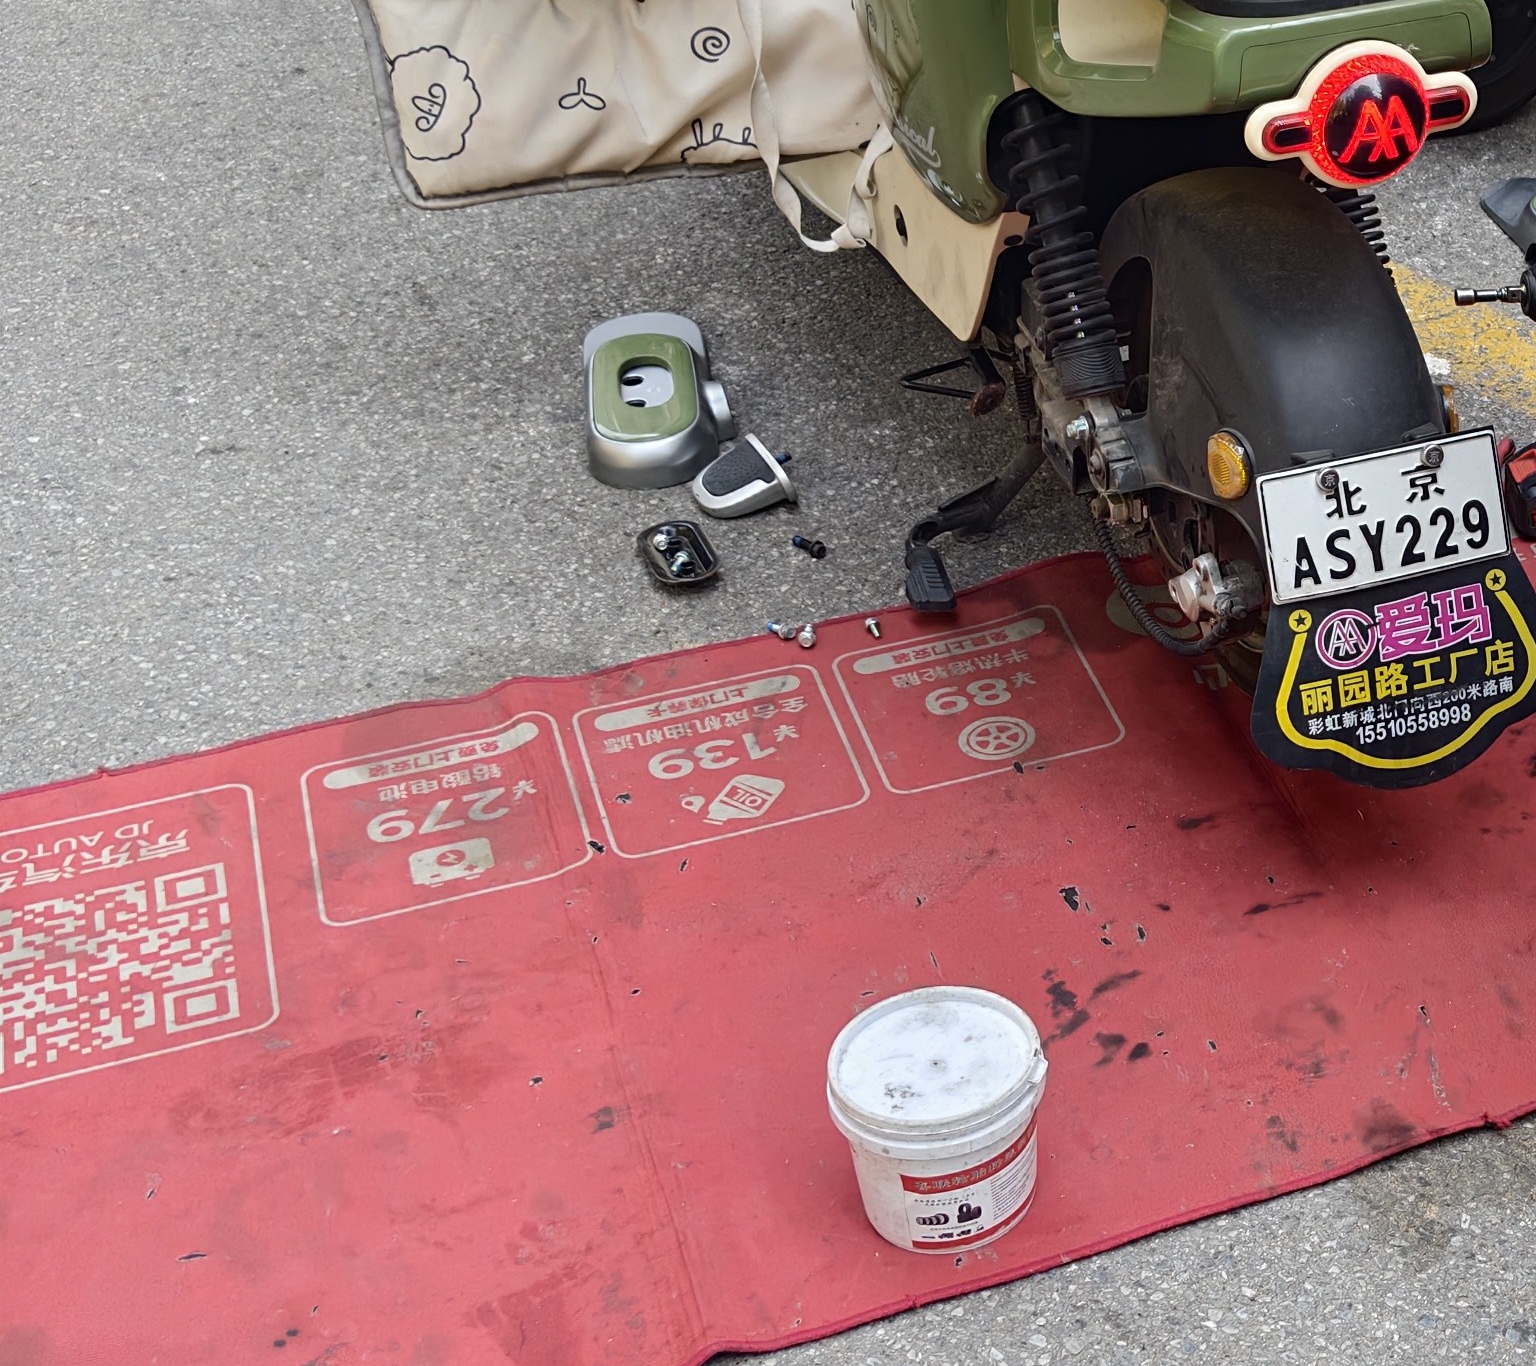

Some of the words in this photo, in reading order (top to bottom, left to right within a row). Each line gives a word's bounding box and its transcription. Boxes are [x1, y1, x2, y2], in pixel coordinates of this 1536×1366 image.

[1293, 498, 1490, 589] ASY229
[1374, 582, 1494, 662] 爱玛
[925, 670, 1037, 716] ¥89
[1298, 639, 1516, 717] 丽园路工厂店
[603, 695, 809, 755] 全合成机油机滤
[647, 723, 801, 780] ¥139
[1355, 703, 1472, 745] 15510558998
[366, 778, 538, 843] ¥279
[377, 762, 502, 802] 铅酸电池
[0, 830, 105, 864] AUTO
[114, 819, 154, 839] JD
